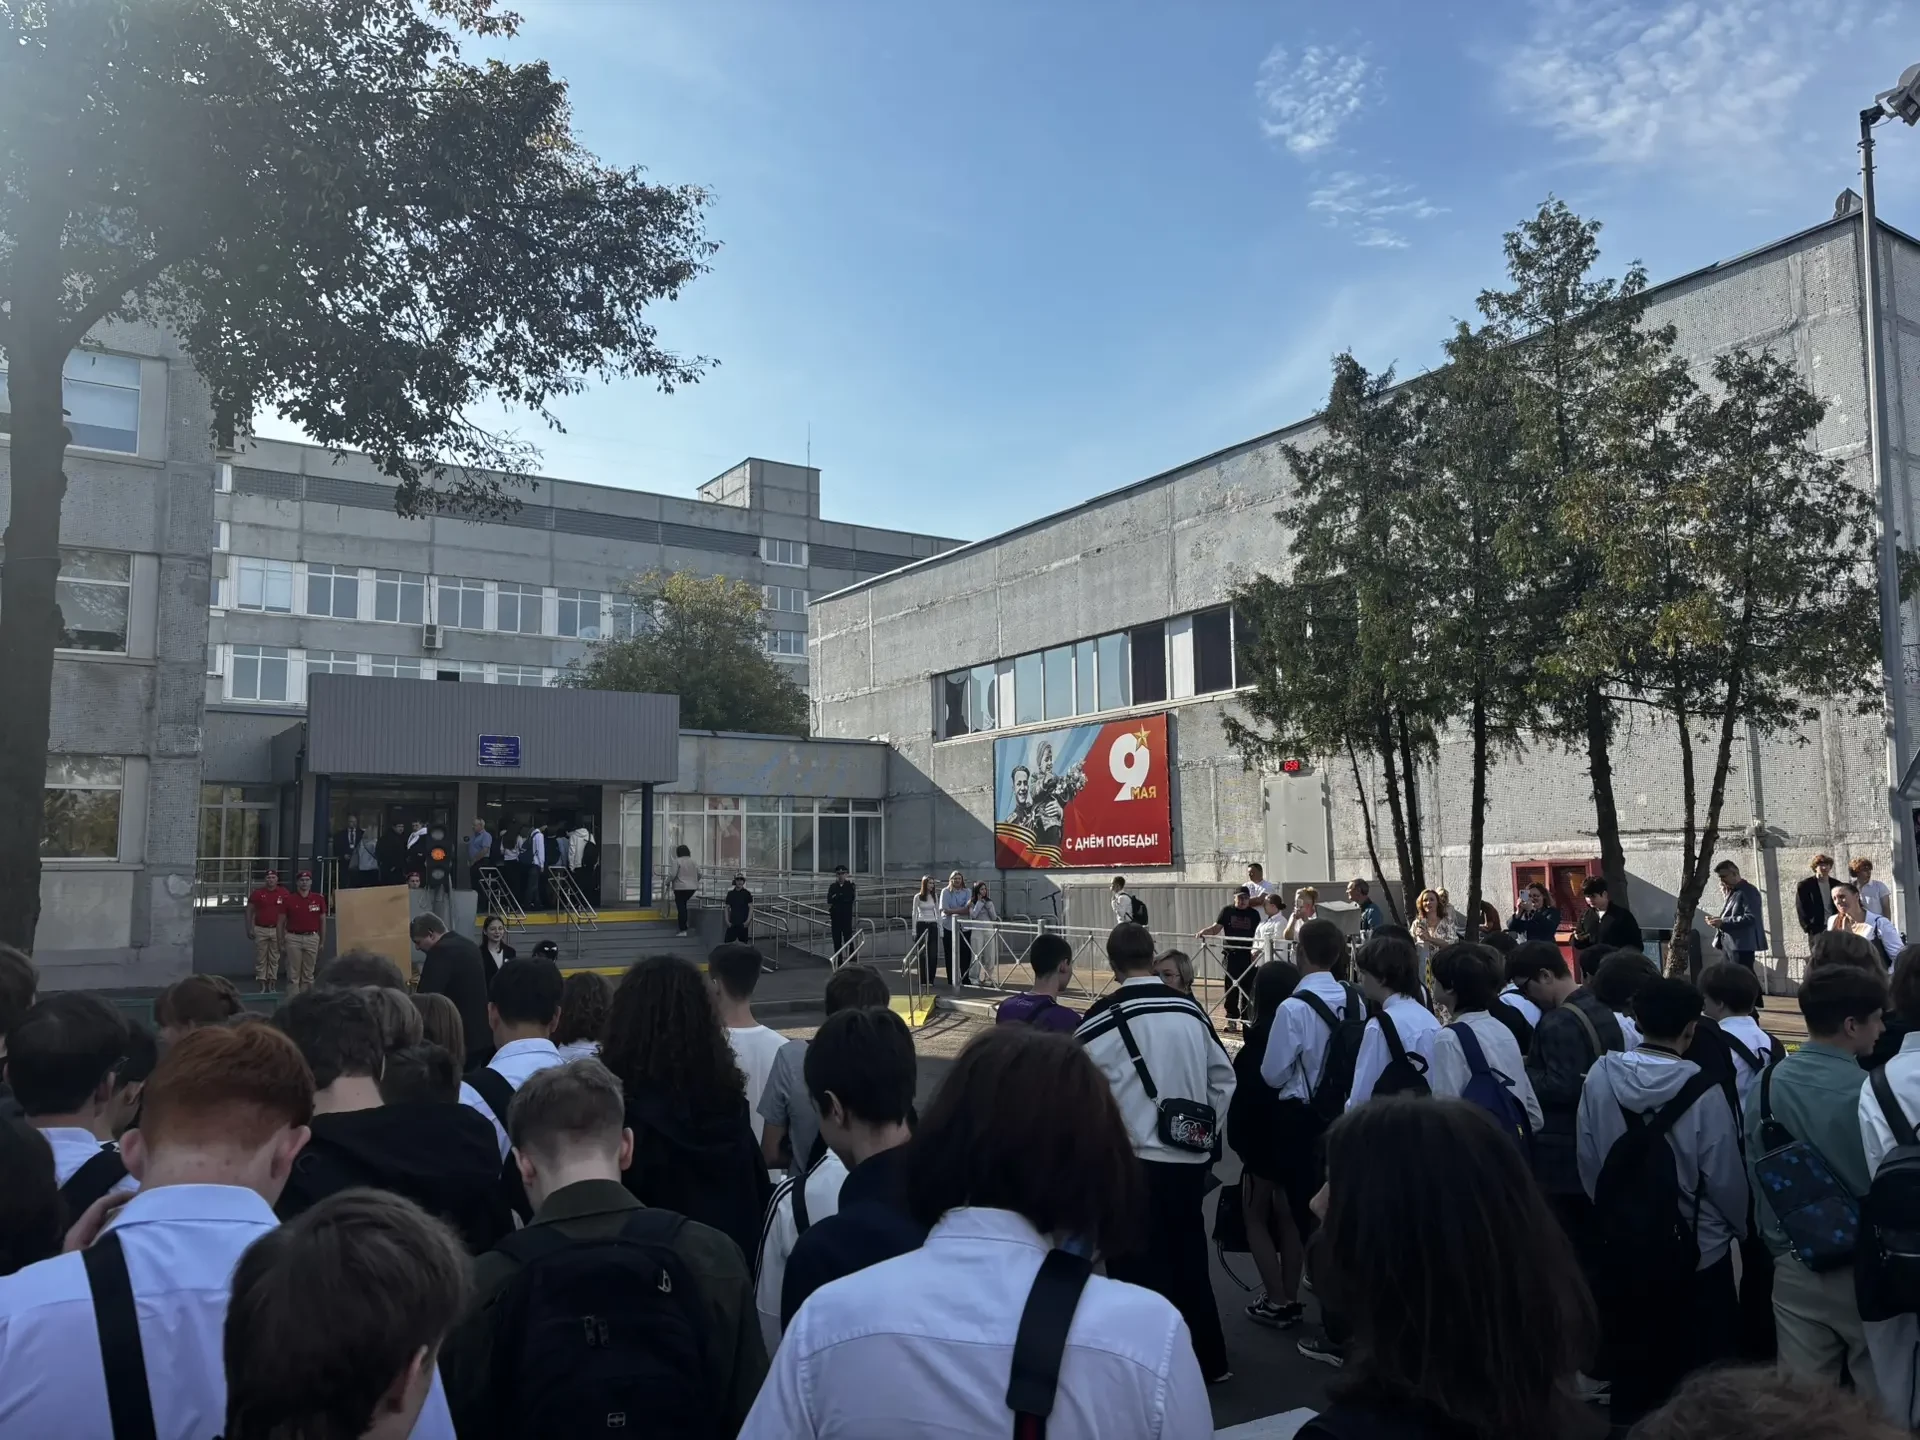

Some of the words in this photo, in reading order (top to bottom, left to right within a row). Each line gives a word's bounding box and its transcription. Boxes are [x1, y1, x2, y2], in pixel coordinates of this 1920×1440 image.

[1109, 733, 1150, 801] 9
[1131, 786, 1157, 800] МАЯ
[1066, 838, 1072, 849] С
[1075, 834, 1104, 851] ДНЁМ
[1107, 833, 1158, 848] ПОБЕДЫ!
